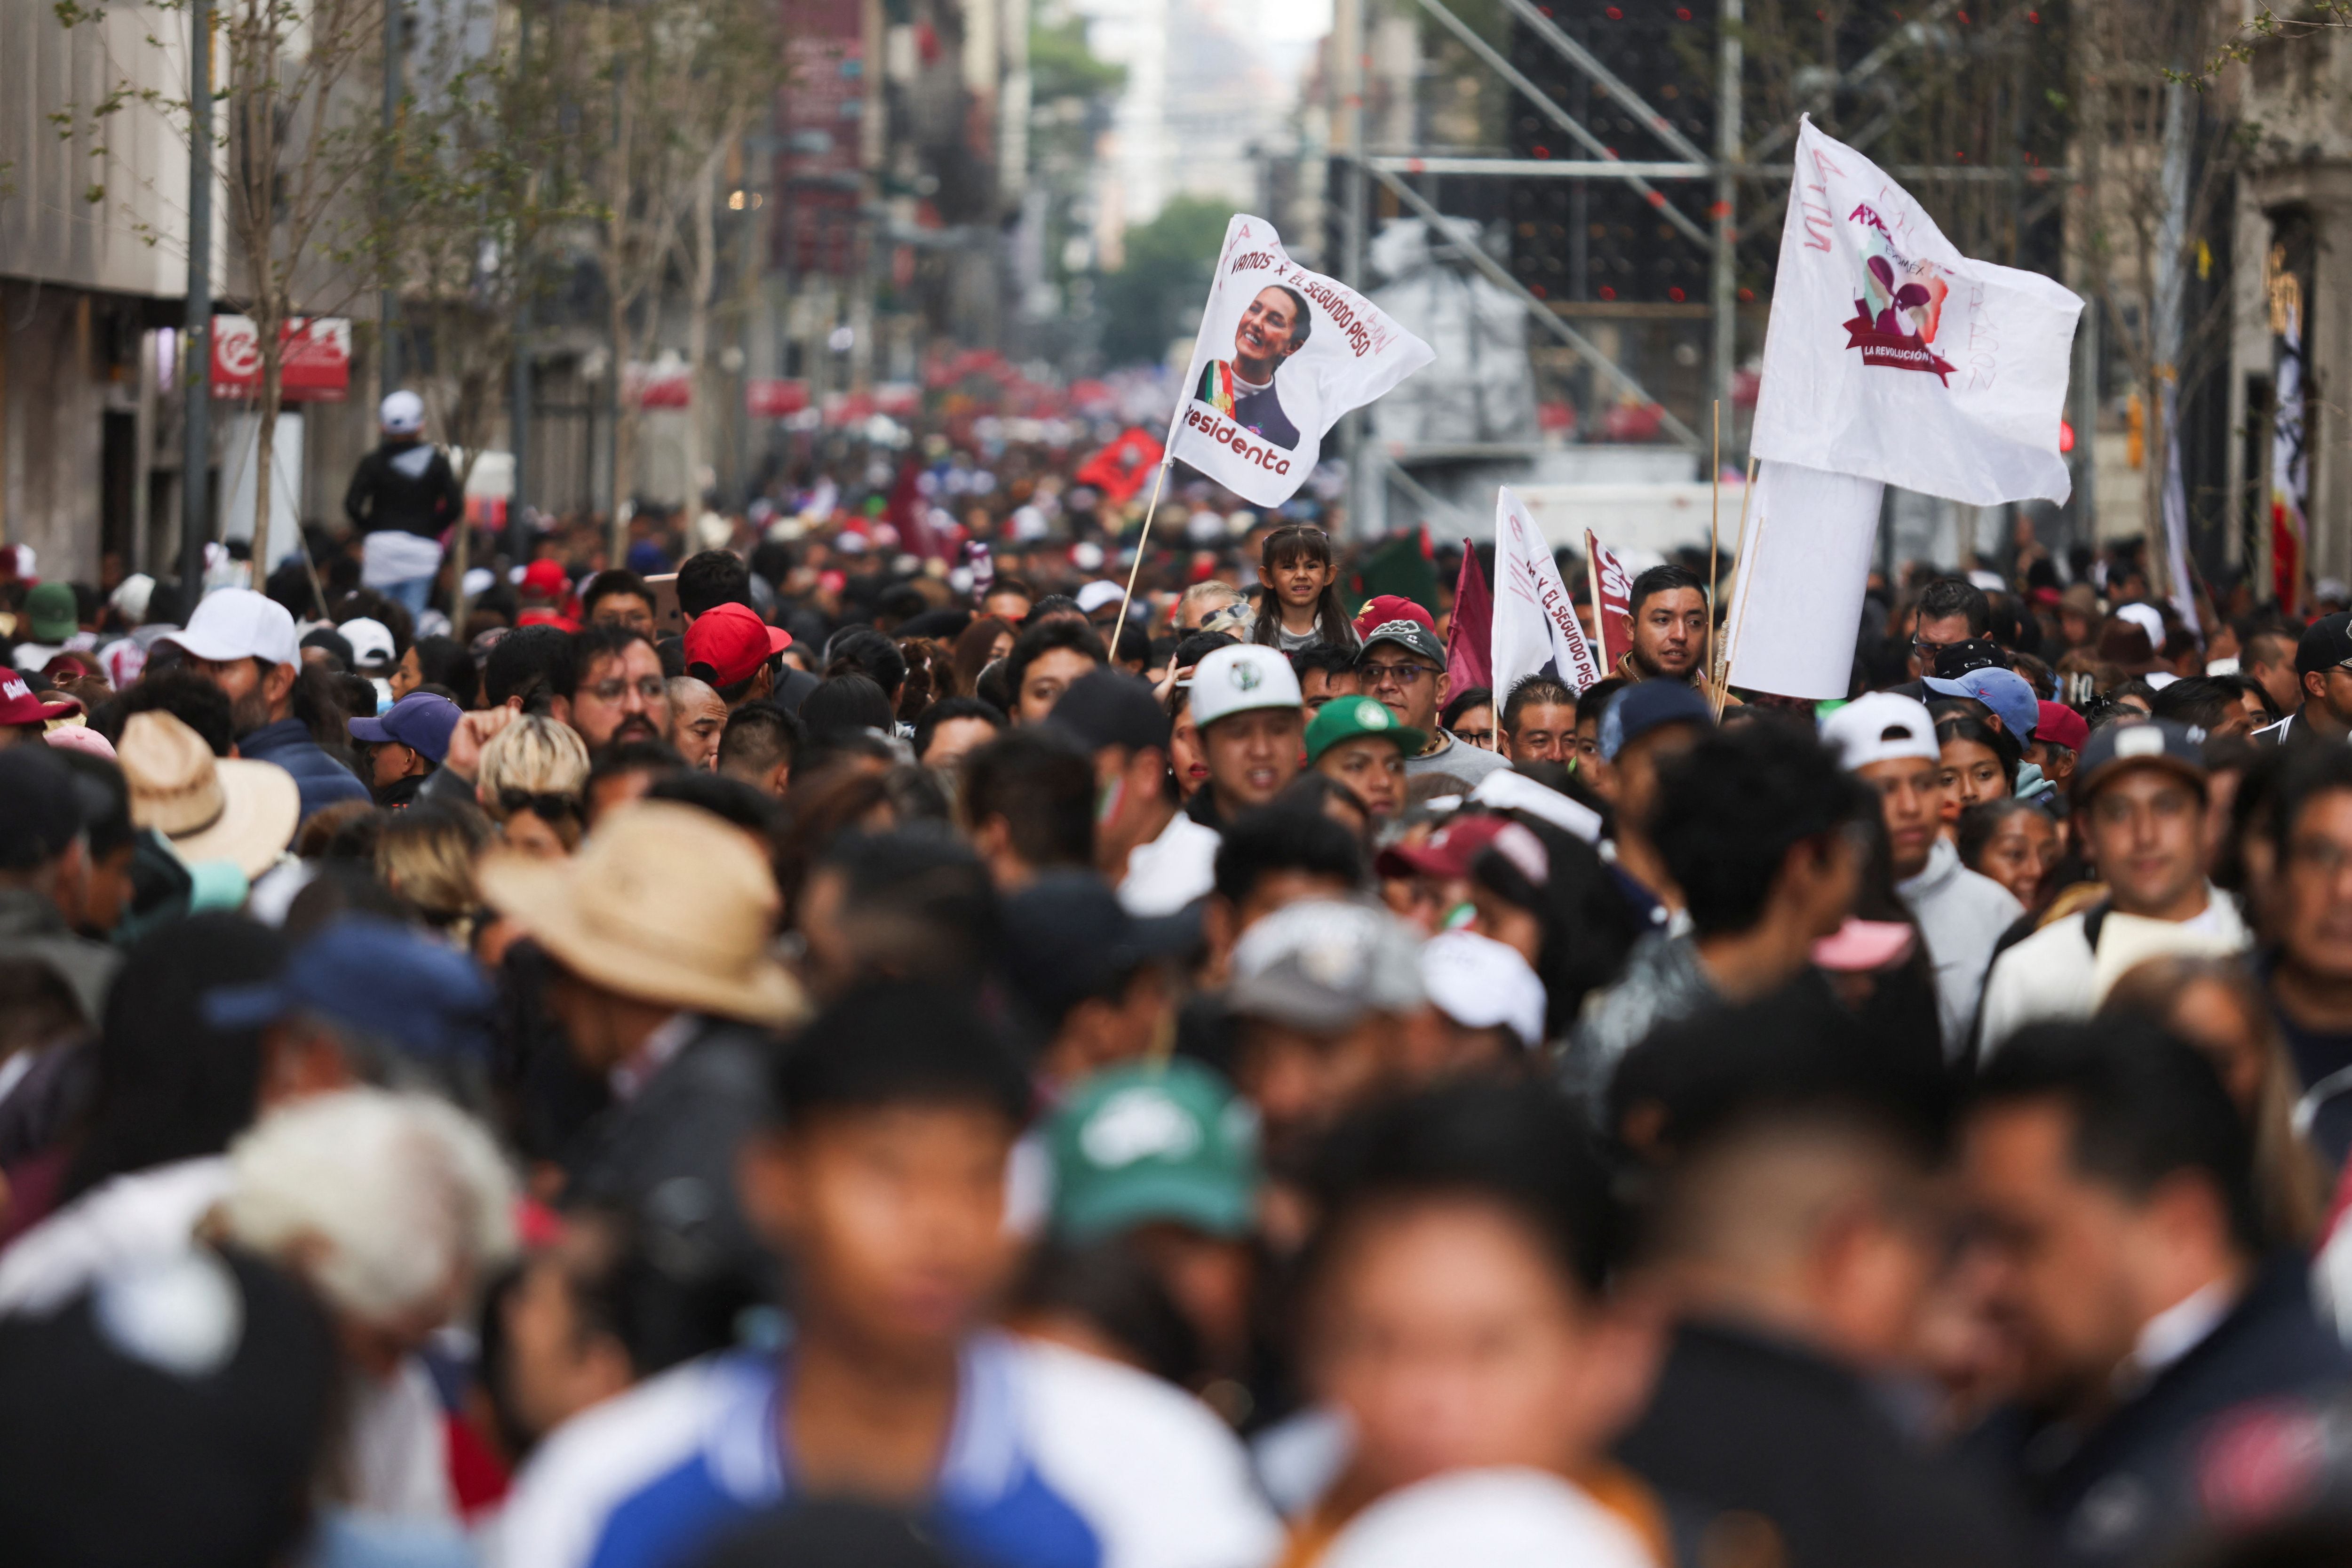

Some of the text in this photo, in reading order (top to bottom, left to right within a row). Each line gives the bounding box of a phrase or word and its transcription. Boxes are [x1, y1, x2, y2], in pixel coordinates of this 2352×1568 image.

[1231, 251, 1276, 275] VAMOS
[1288, 274, 1303, 287] EL
[1303, 281, 1354, 329] SEGUNDO
[1345, 320, 1371, 358] PISO
[1865, 346, 1875, 355] LA
[1875, 346, 1929, 361] REVOLUCIÓN
[1542, 589, 1560, 610] EL
[1552, 605, 1587, 661] SEGUNDO
